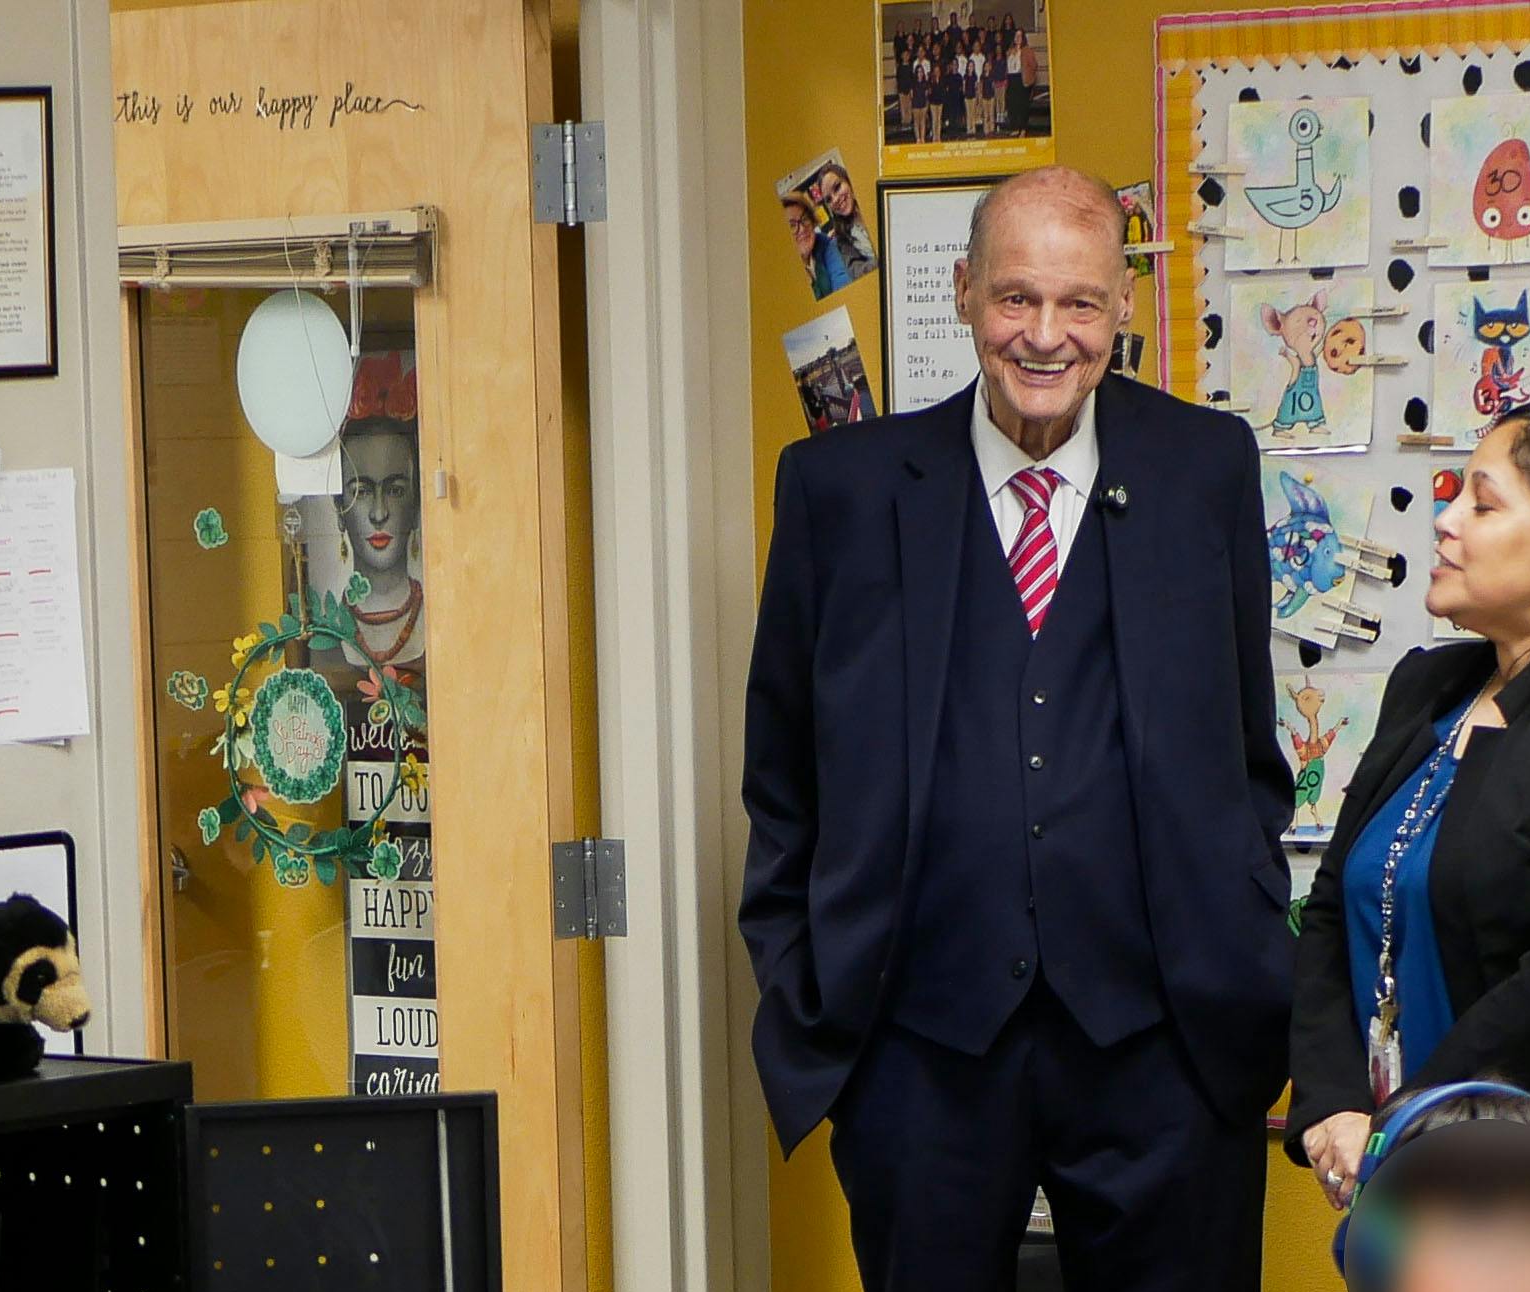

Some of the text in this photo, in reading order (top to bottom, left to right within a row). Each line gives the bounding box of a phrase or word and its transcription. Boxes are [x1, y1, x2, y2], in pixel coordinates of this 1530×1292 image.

[114, 81, 405, 131] this is our happy place
[1485, 169, 1523, 198] 30
[905, 243, 928, 253] Good
[906, 266, 930, 277] Eyes
[906, 280, 941, 289] Hearts
[908, 368, 958, 379] let's go.
[1291, 391, 1315, 415] 10
[354, 771, 384, 812] TO
[388, 943, 426, 992] fun
[377, 1006, 439, 1047] LOUD
